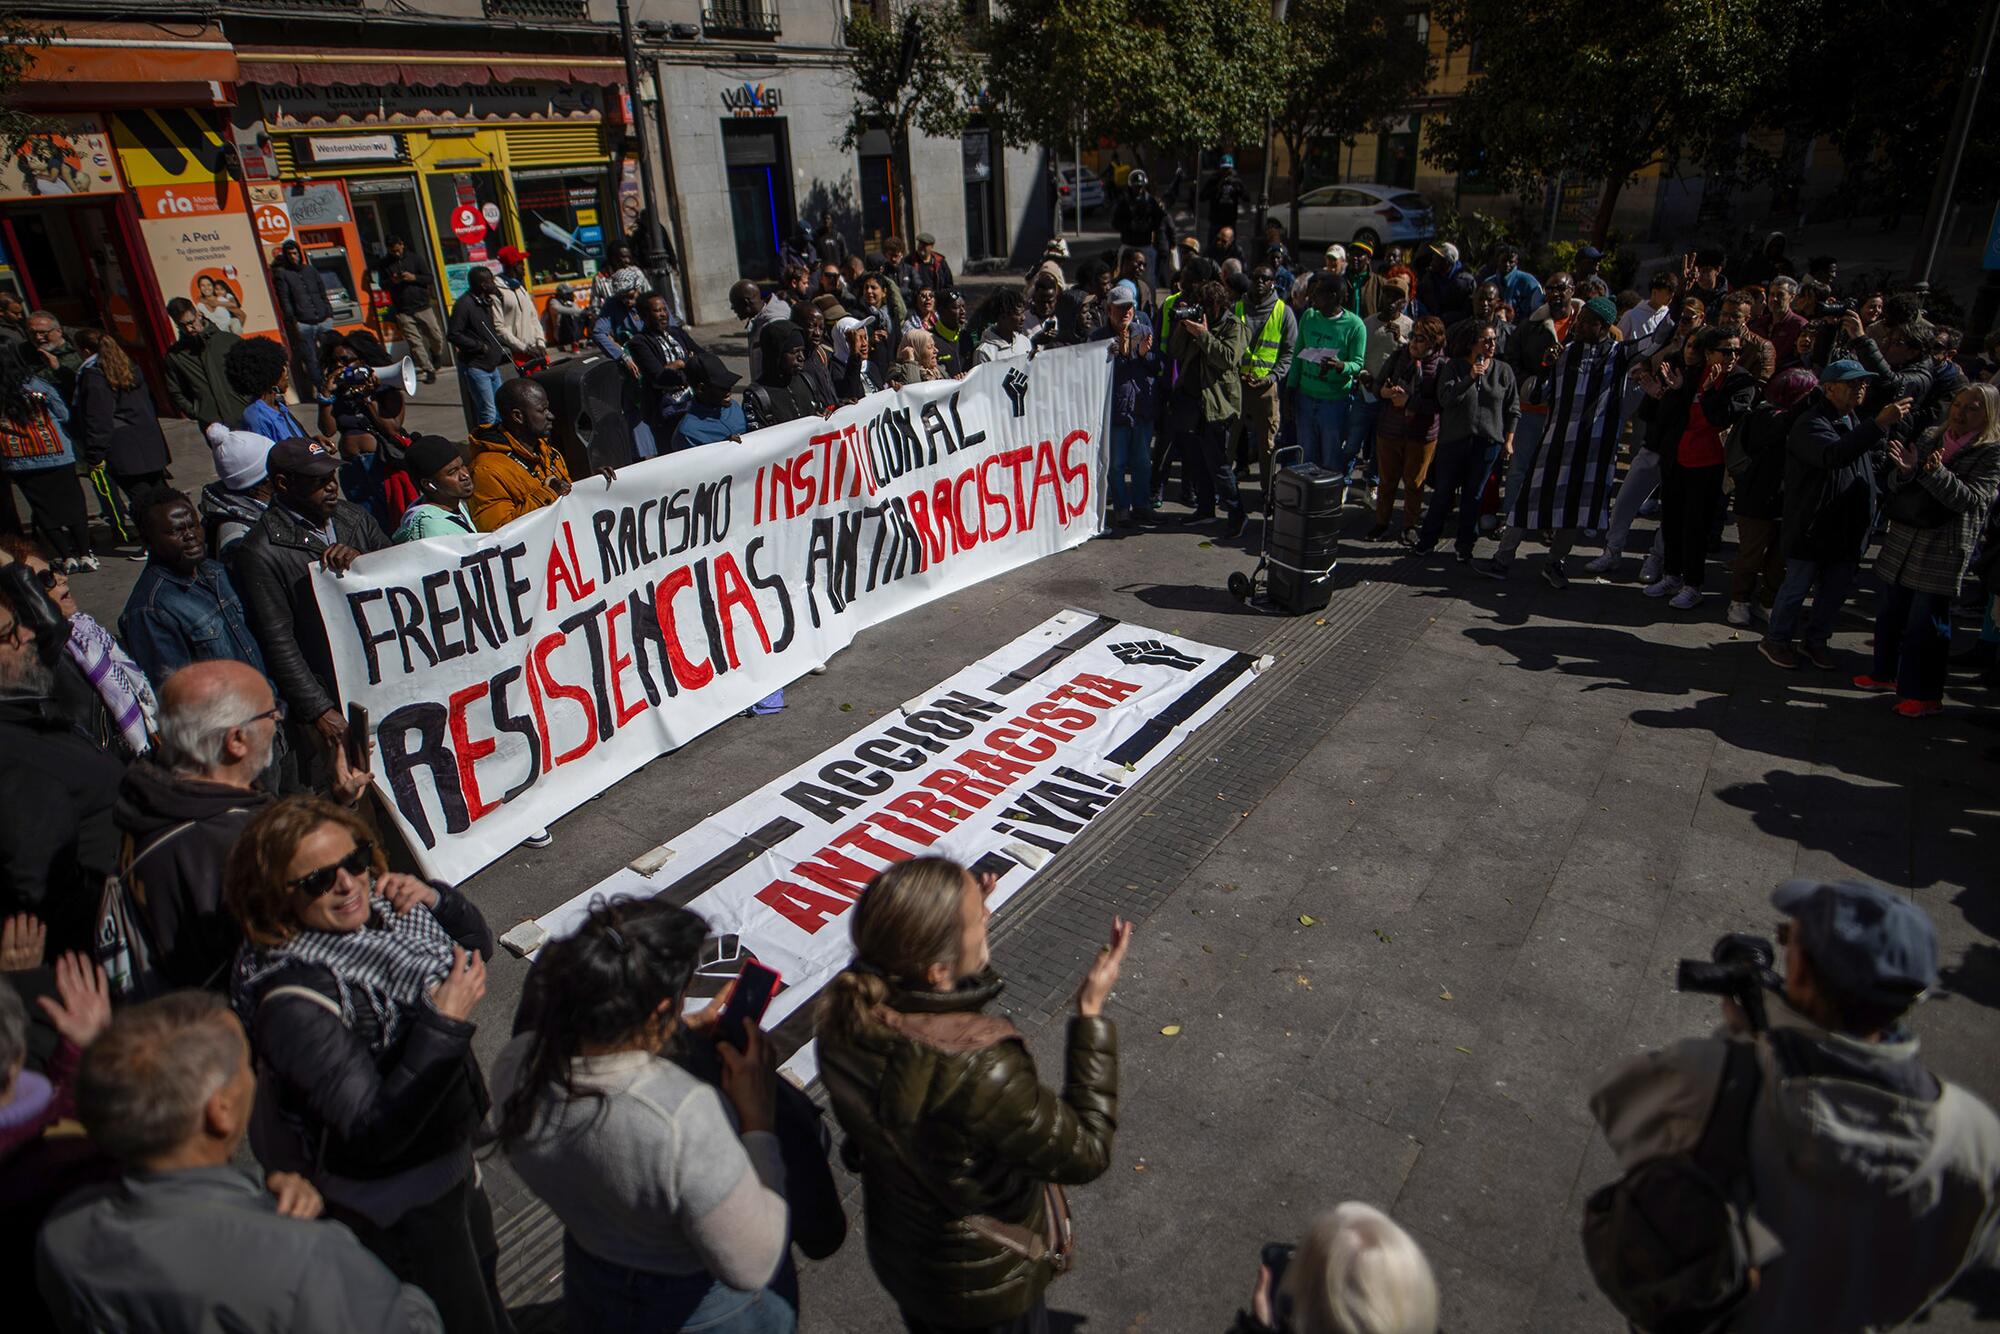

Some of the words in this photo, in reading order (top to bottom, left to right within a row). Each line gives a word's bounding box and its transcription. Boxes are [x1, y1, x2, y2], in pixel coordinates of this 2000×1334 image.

[261, 86, 317, 101] MOON
[391, 86, 403, 98] &
[407, 85, 465, 99] MONEY
[467, 85, 537, 98] TRANSFER
[315, 143, 372, 153] WesternUnion
[157, 189, 193, 214] ria
[256, 209, 287, 230] ria
[181, 233, 192, 243] A
[193, 229, 220, 242] Perú
[346, 542, 533, 685] FRENTE
[545, 521, 595, 611] AL
[593, 475, 732, 579] RACISMO
[377, 536, 795, 850] RESISTENCIAS
[806, 430, 1093, 628] ANTIRRACISTAS
[780, 690, 1008, 824] ACCION
[754, 672, 1143, 934] ANTIRRACISTA
[991, 766, 1127, 854] ¡YA!
